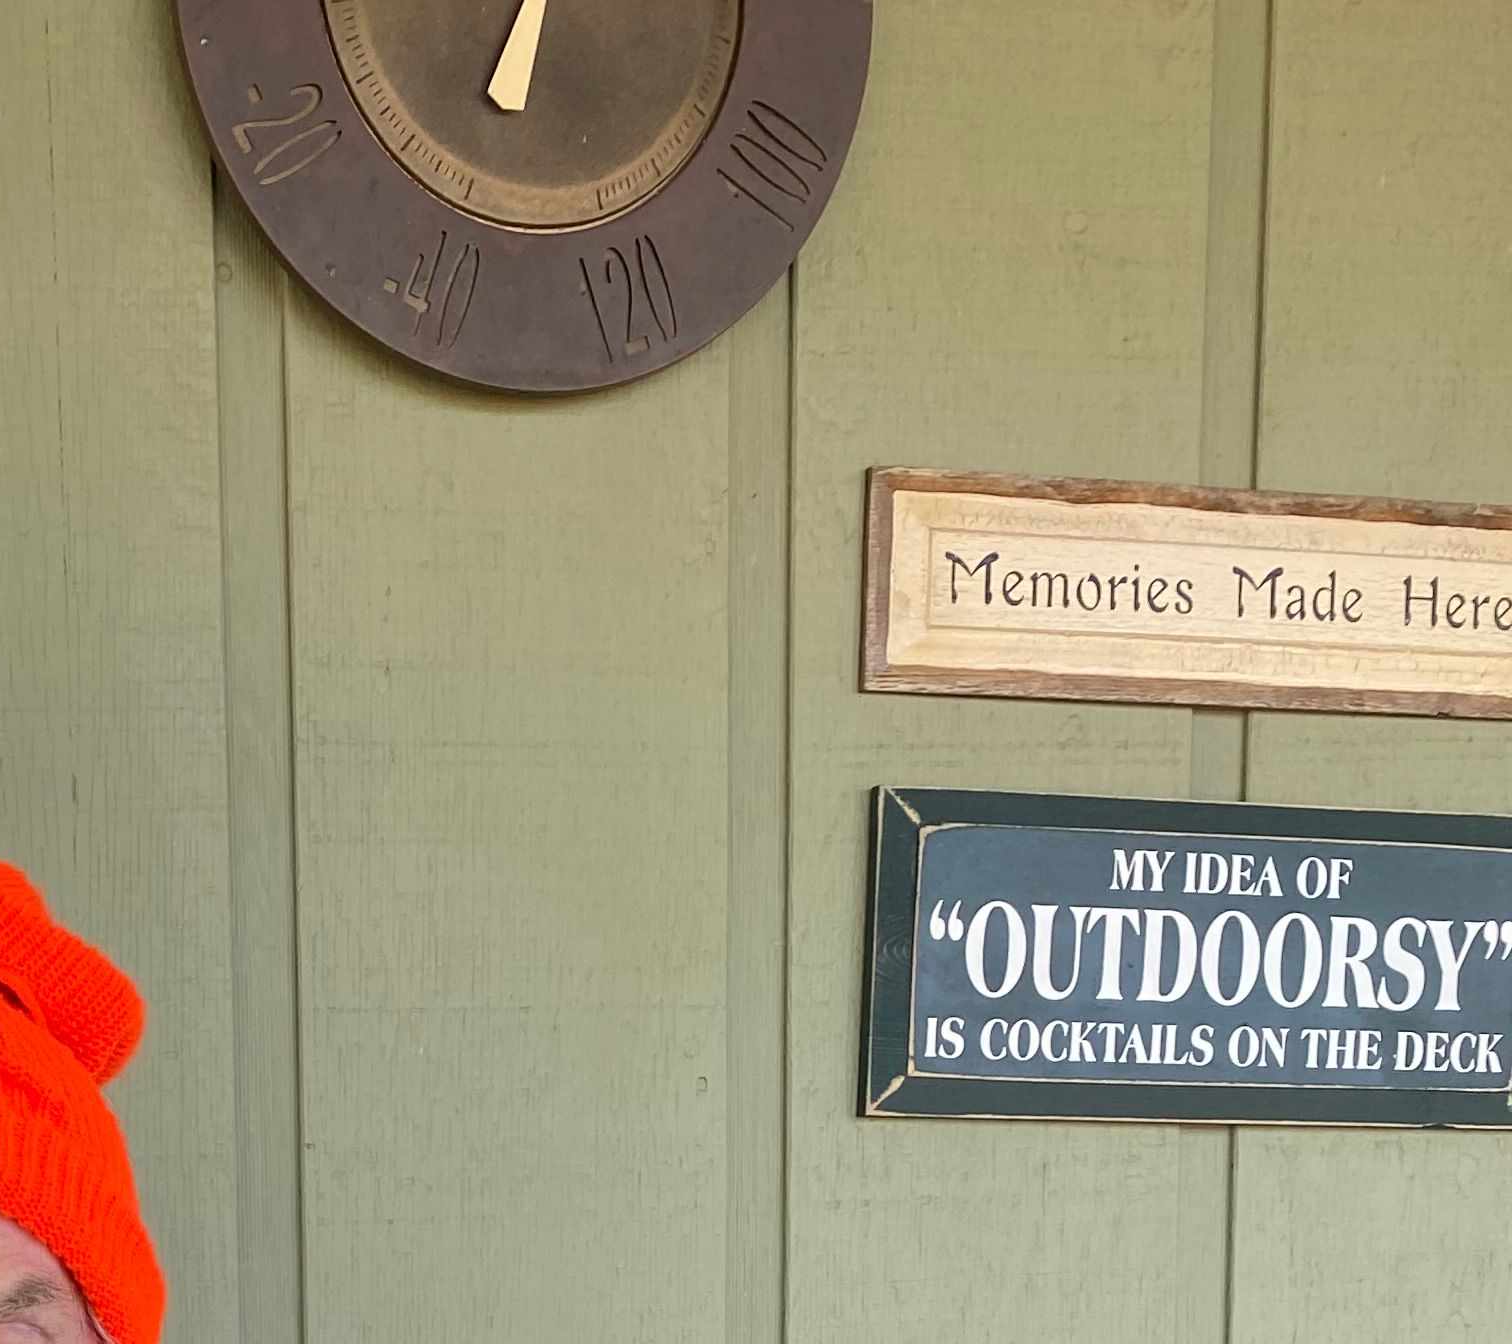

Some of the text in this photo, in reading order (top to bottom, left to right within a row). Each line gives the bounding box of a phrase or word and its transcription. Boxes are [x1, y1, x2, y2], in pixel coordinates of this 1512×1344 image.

[714, 100, 827, 232] 100
[579, 234, 677, 363] 120
[945, 551, 1511, 632] Memories Made Here
[1108, 848, 1354, 899] MY IDEA OF
[928, 899, 1511, 1012] “OUTDOORSY”
[924, 1016, 1504, 1074] IS COCKTAILS ON THE DECK
